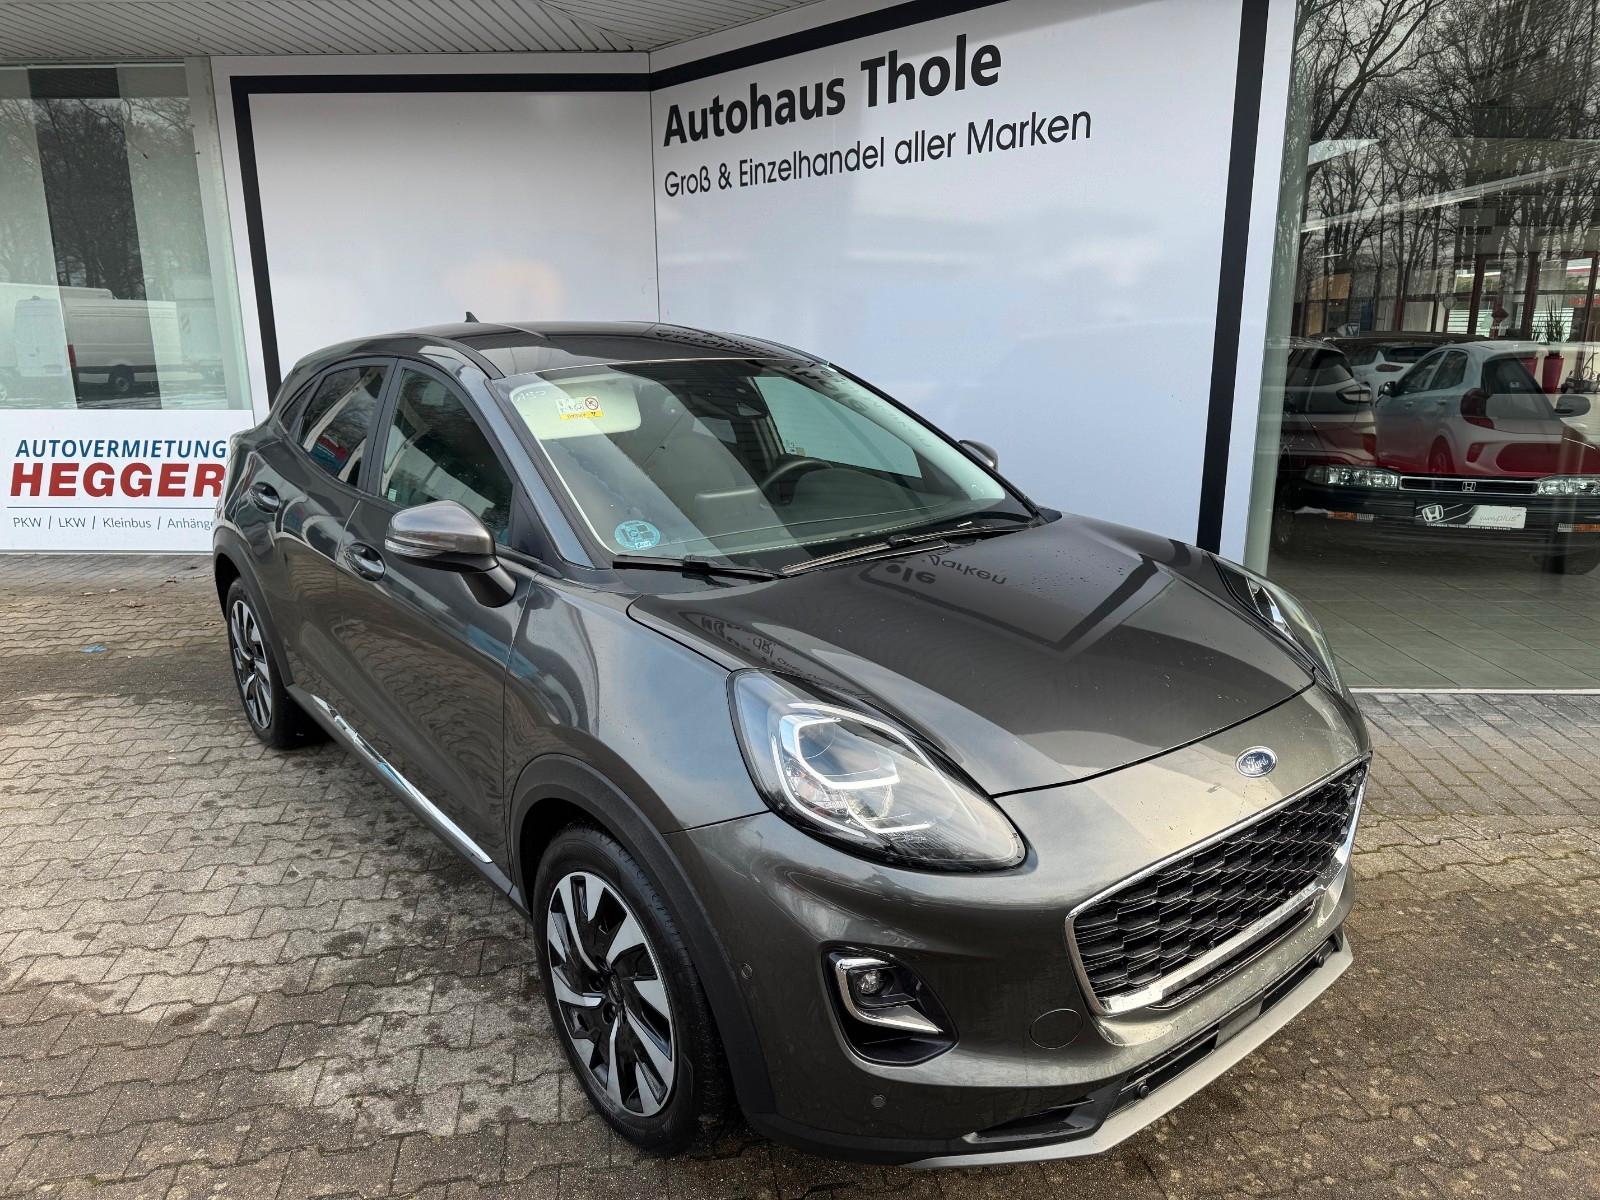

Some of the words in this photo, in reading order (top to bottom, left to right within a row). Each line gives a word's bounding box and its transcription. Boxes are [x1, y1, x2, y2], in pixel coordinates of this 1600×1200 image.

[664, 77, 845, 147] Autohaus
[860, 34, 1001, 107] Thole
[664, 162, 711, 198] Groß
[718, 162, 733, 190] &
[739, 136, 884, 188] Einzelhandel
[894, 129, 957, 165] aller
[967, 110, 1092, 156] Marken
[15, 439, 227, 458] AUTOVERMIETUNG
[10, 462, 226, 498] HEGGER
[12, 517, 42, 528] PKW
[58, 517, 86, 528] LKW
[102, 517, 152, 529] Kleinbus
